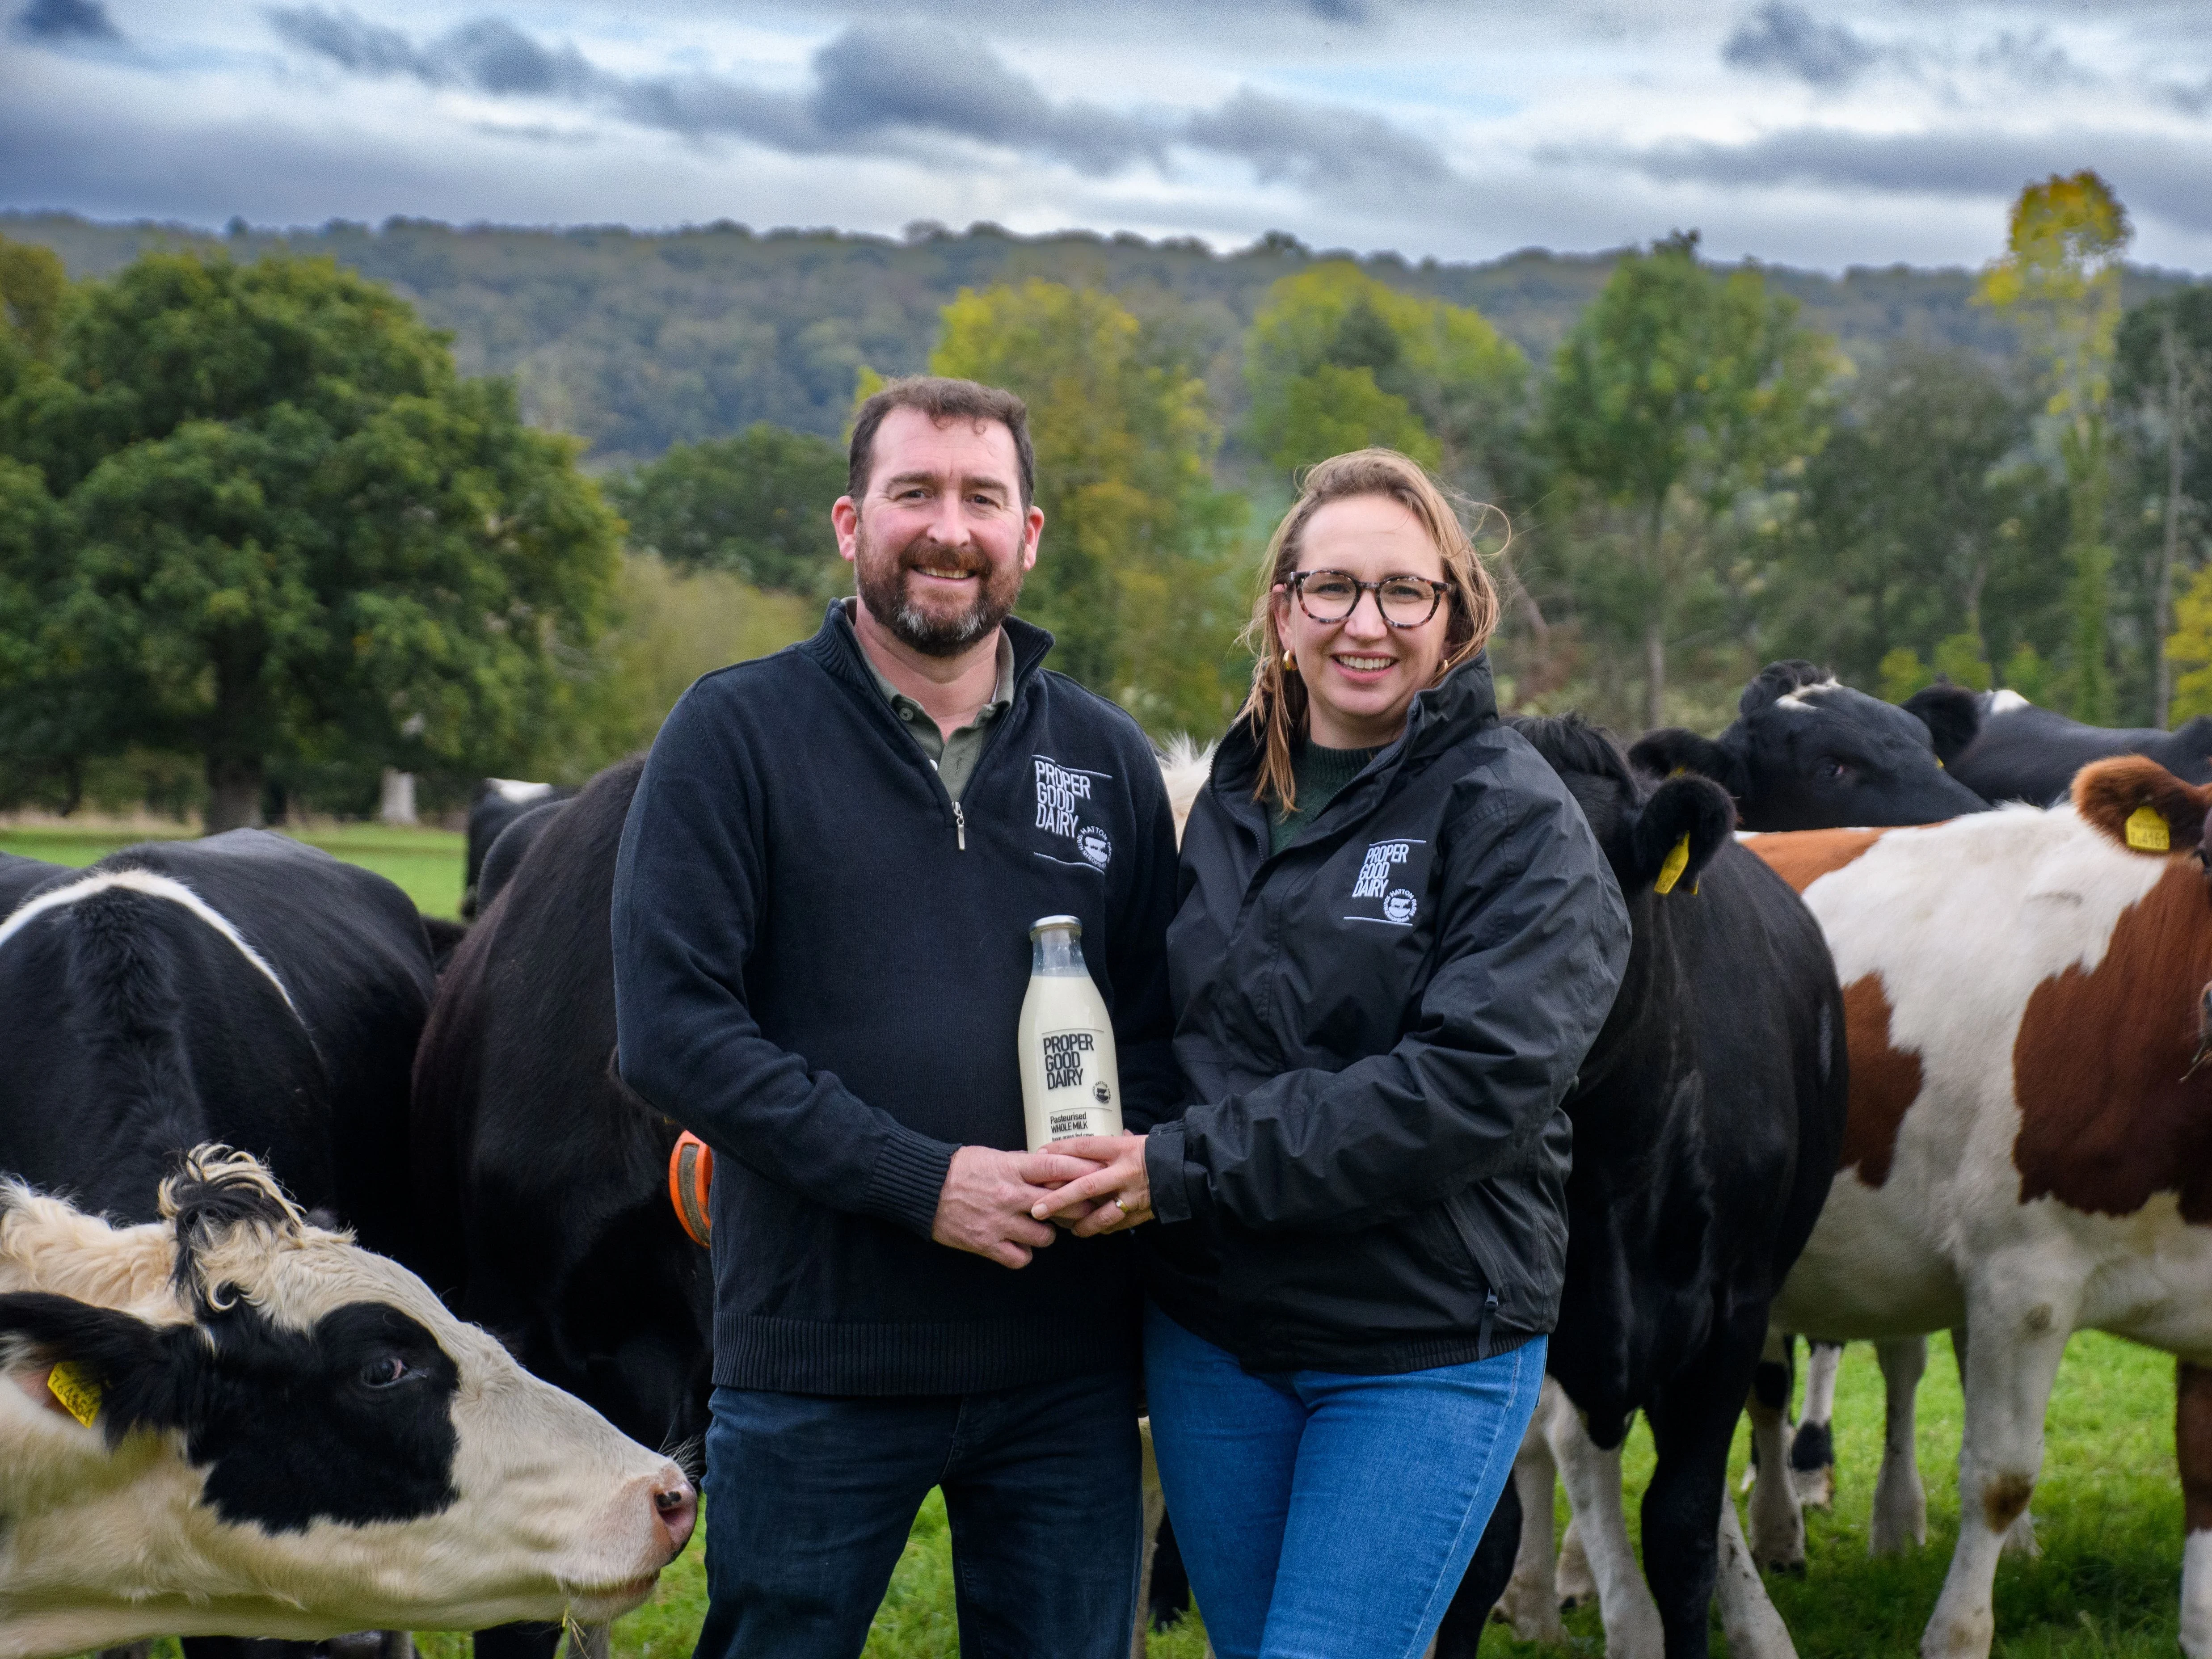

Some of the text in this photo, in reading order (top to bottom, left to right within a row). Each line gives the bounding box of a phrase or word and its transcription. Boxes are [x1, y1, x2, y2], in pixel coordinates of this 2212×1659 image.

[1034, 760, 1091, 800] PROPER
[1036, 782, 1074, 813] GOOD
[1035, 803, 1079, 838] DAIRY
[1080, 825, 1107, 841] HATTON
[1364, 843, 1409, 864] PROPER
[1359, 861, 1390, 880] GOOD
[1352, 879, 1389, 897] DAIRY
[1390, 888, 1414, 900] HATTON
[1043, 1033, 1094, 1055] PROPER
[1045, 1051, 1081, 1072] GOOD
[1046, 1068, 1083, 1090] DAIRY
[1050, 1111, 1087, 1124] Pasteurised
[1051, 1121, 1088, 1133] WHOLE MILK
